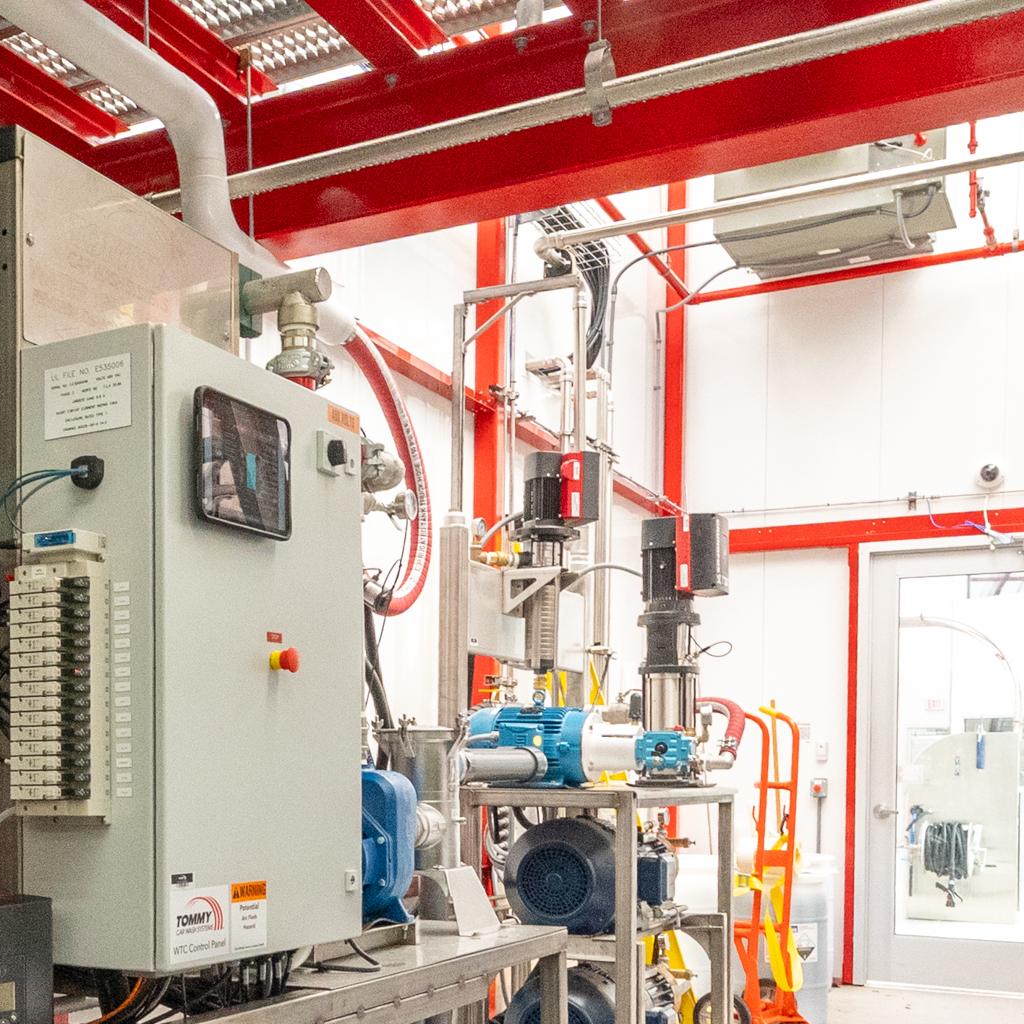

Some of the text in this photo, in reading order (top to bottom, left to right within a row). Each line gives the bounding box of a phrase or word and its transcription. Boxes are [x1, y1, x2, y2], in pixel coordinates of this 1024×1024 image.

[63, 370, 76, 378] FILE
[240, 884, 266, 897] WARNING
[176, 911, 212, 928] TOMMY
[173, 945, 188, 955] WTC
[189, 941, 210, 952] Control
[212, 938, 226, 948] Panel
